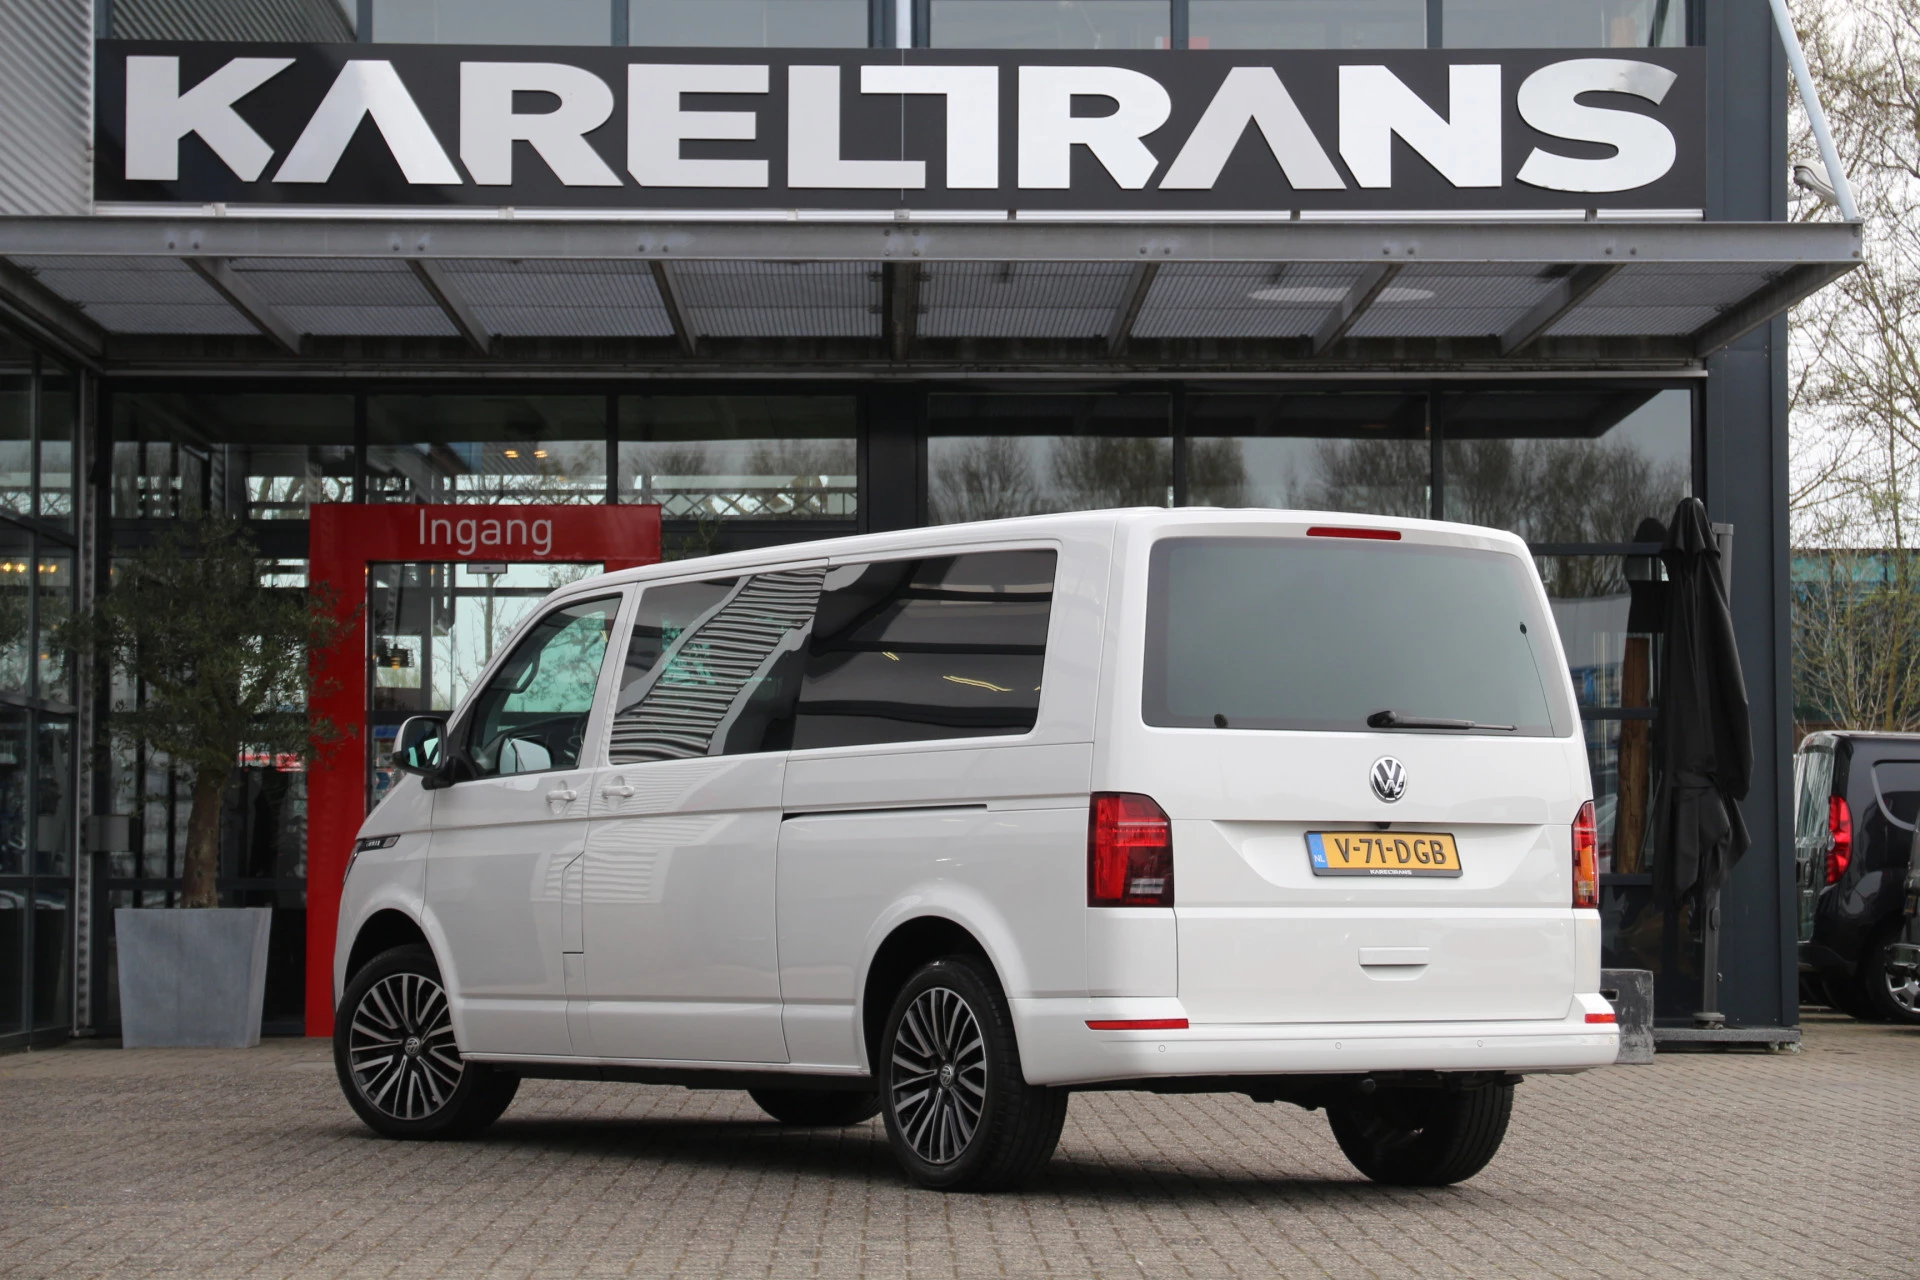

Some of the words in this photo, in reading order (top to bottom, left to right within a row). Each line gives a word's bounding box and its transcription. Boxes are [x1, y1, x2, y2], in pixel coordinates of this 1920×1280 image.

[125, 55, 1677, 193] KARELTRANS
[419, 509, 552, 555] Ingang
[1371, 757, 1406, 800] VW
[1313, 855, 1326, 863] NL
[1334, 837, 1447, 865] V-71-DGB
